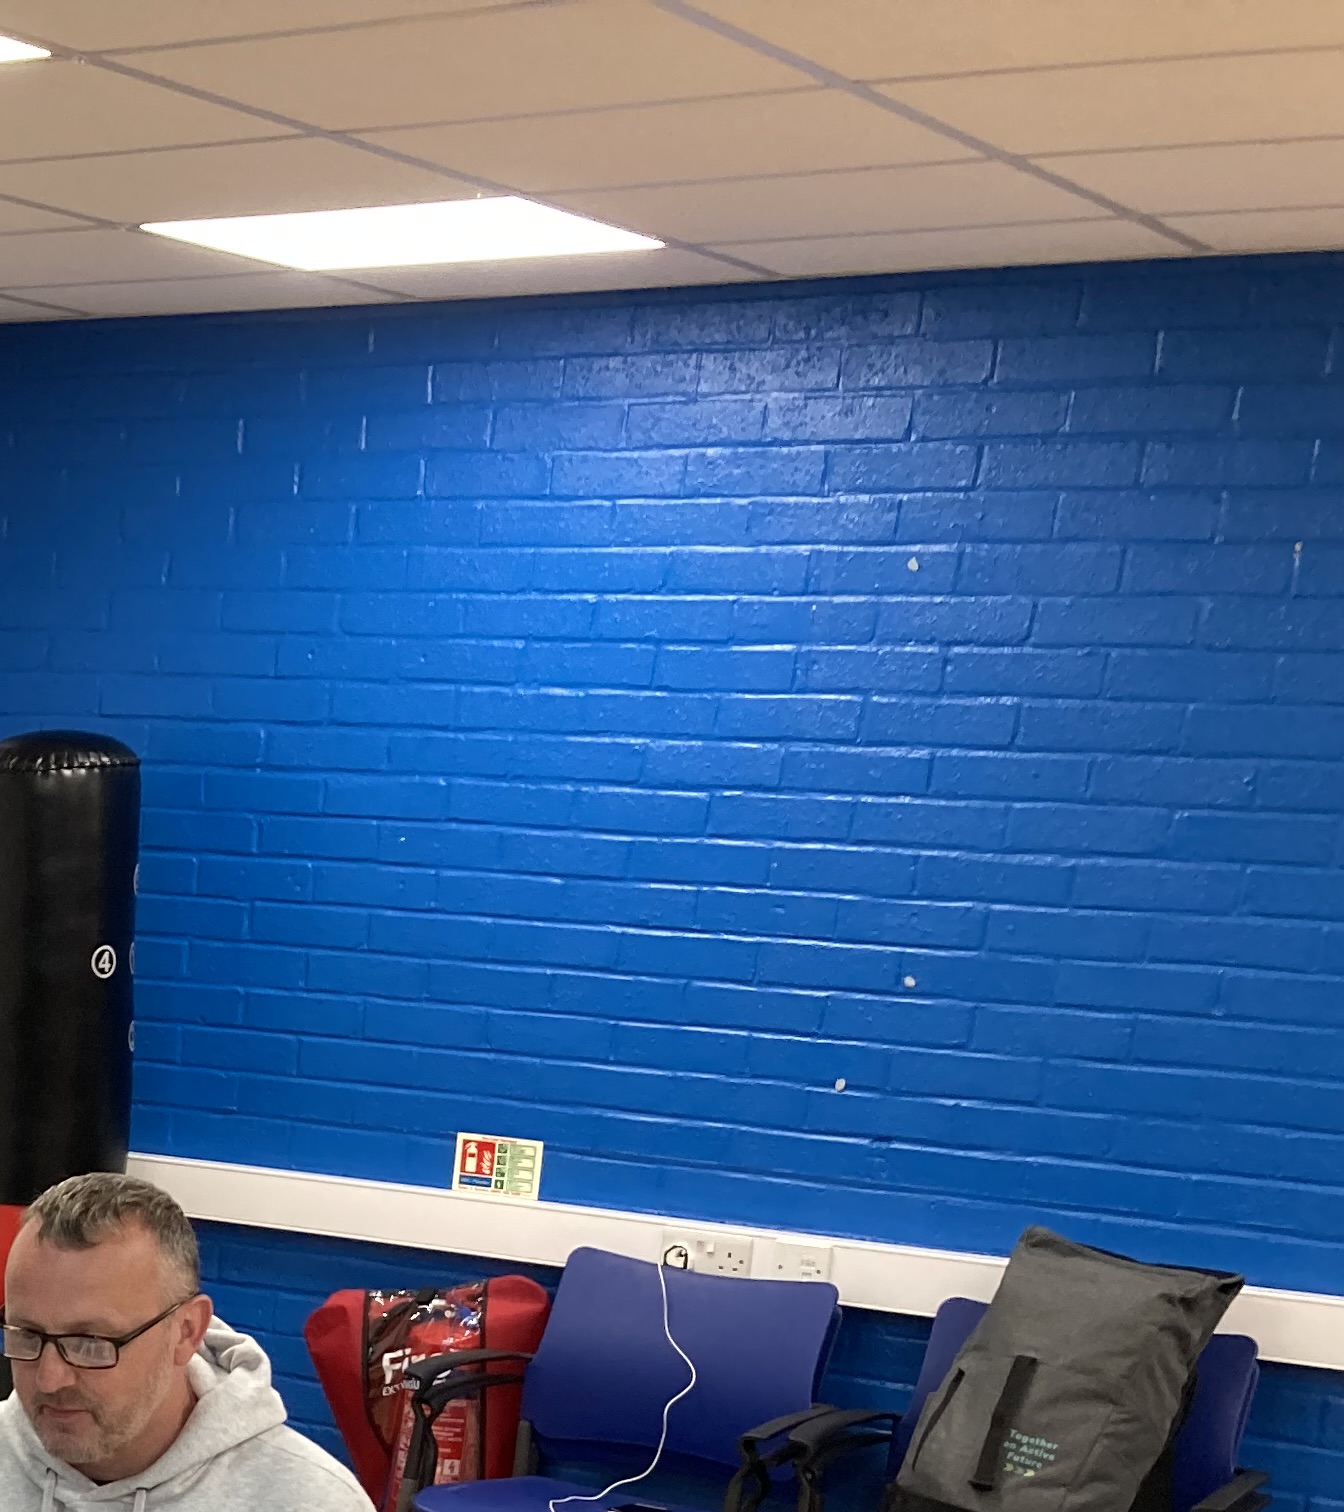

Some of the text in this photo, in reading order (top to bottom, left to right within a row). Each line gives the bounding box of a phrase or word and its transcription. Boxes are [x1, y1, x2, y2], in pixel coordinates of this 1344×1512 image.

[98, 951, 111, 972] 4
[1010, 1429, 1058, 1451] Together
[1006, 1451, 1043, 1469] Future
[1020, 1442, 1056, 1462] Active
